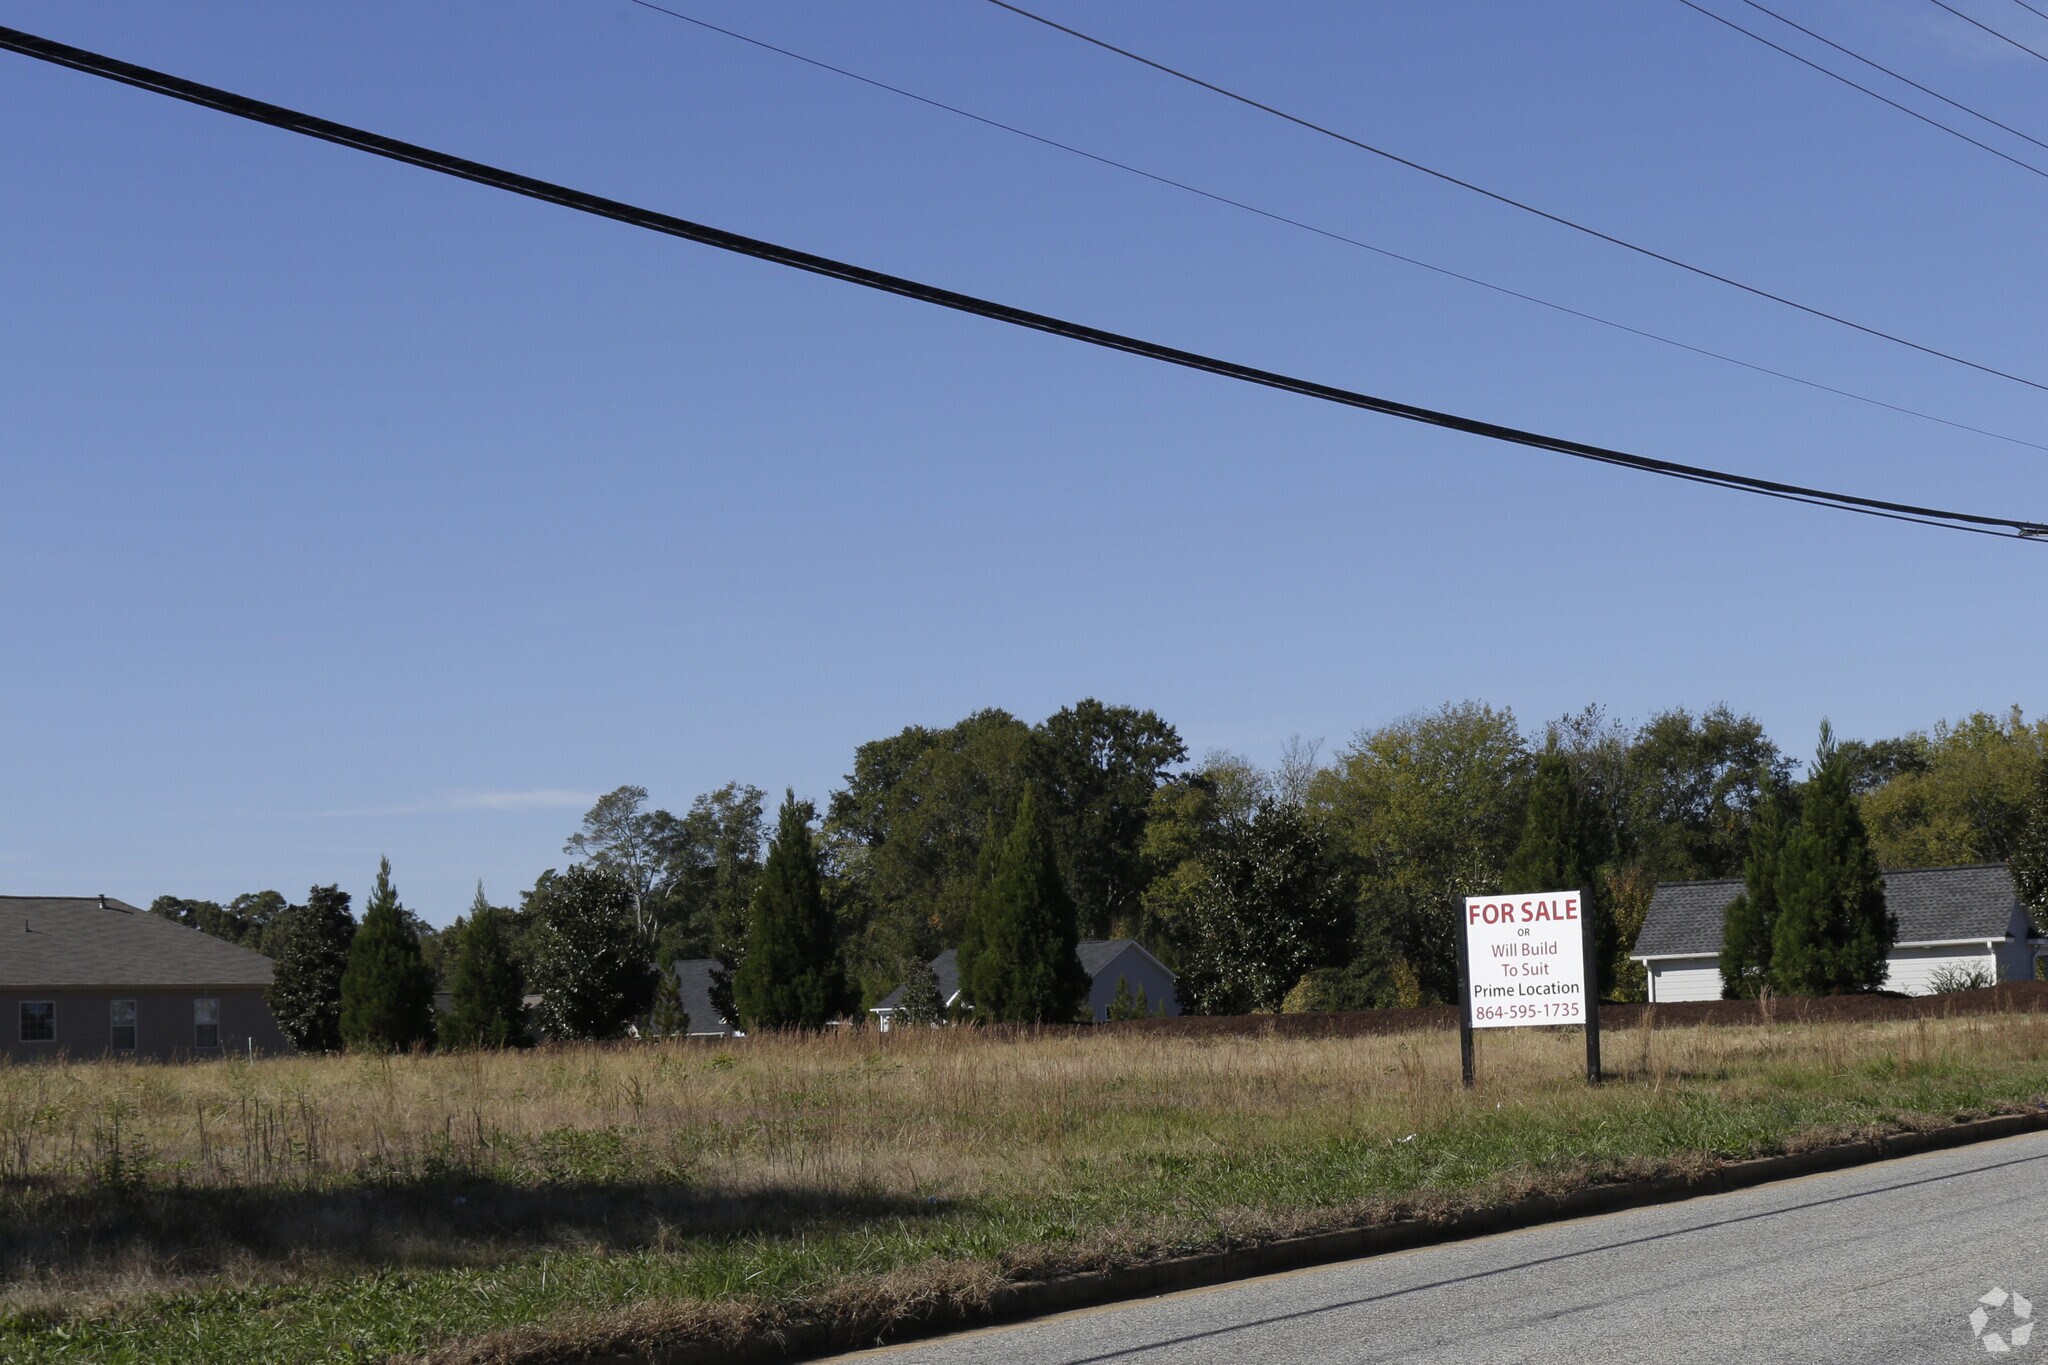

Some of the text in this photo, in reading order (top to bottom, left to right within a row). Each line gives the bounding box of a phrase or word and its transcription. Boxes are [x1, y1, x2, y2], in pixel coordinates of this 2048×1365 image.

[1469, 899, 1578, 925] FOR SALE
[1517, 928, 1530, 937] OR
[1492, 941, 1557, 958] Will Build
[1502, 962, 1549, 977] To Suit
[1474, 981, 1579, 998] Prime Location
[1476, 1002, 1579, 1020] 864-595-1735
